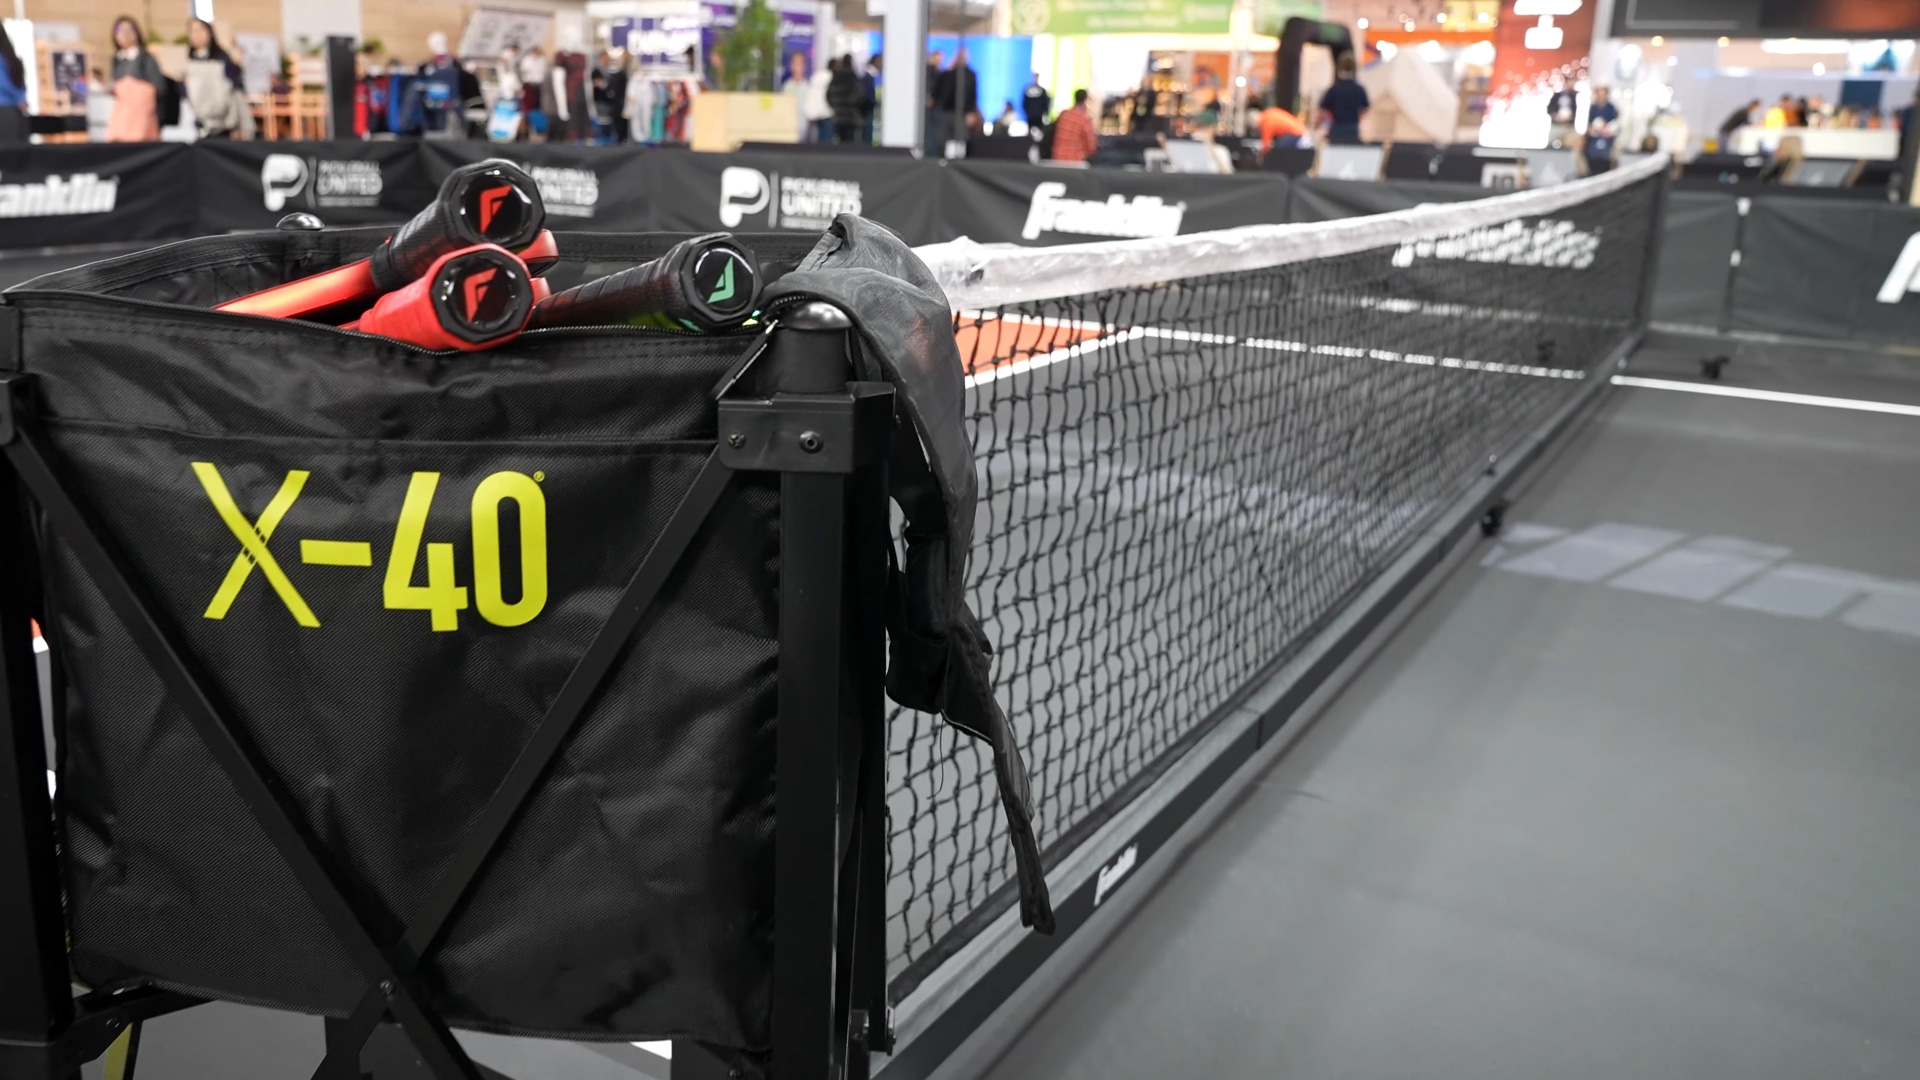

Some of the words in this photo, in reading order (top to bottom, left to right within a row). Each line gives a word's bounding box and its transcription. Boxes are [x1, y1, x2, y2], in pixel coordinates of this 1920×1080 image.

[0, 172, 117, 218] anklin
[317, 173, 383, 195] UNITED
[539, 182, 599, 206] NITED
[781, 192, 862, 217] UNITED
